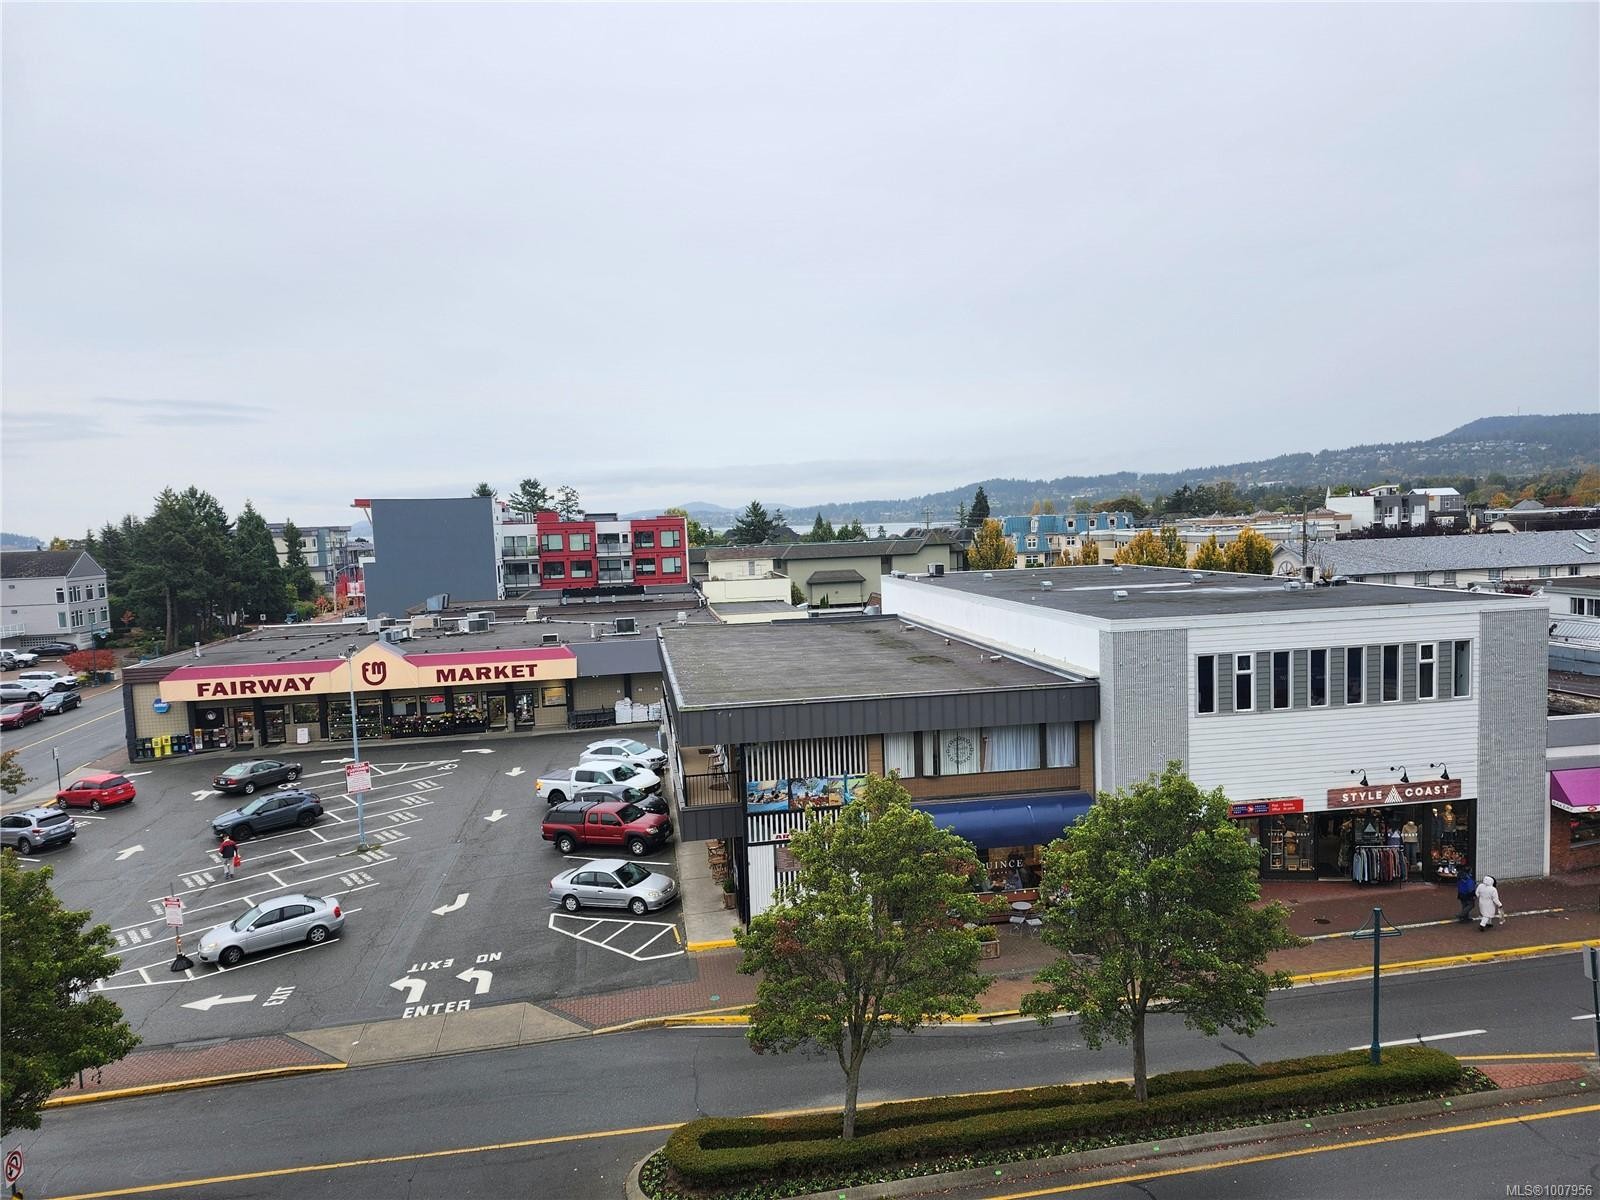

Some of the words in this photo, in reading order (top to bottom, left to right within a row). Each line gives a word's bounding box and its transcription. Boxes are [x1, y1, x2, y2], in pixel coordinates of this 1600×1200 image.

[196, 676, 315, 697] FAIRWAY
[436, 664, 538, 682] MARKET
[1342, 791, 1382, 802] STYLE
[1405, 785, 1449, 797] COAST
[986, 859, 1023, 870] UINCE
[406, 958, 455, 973] EXIT
[262, 986, 296, 1007] EXIT
[402, 999, 471, 1019] ENTER
